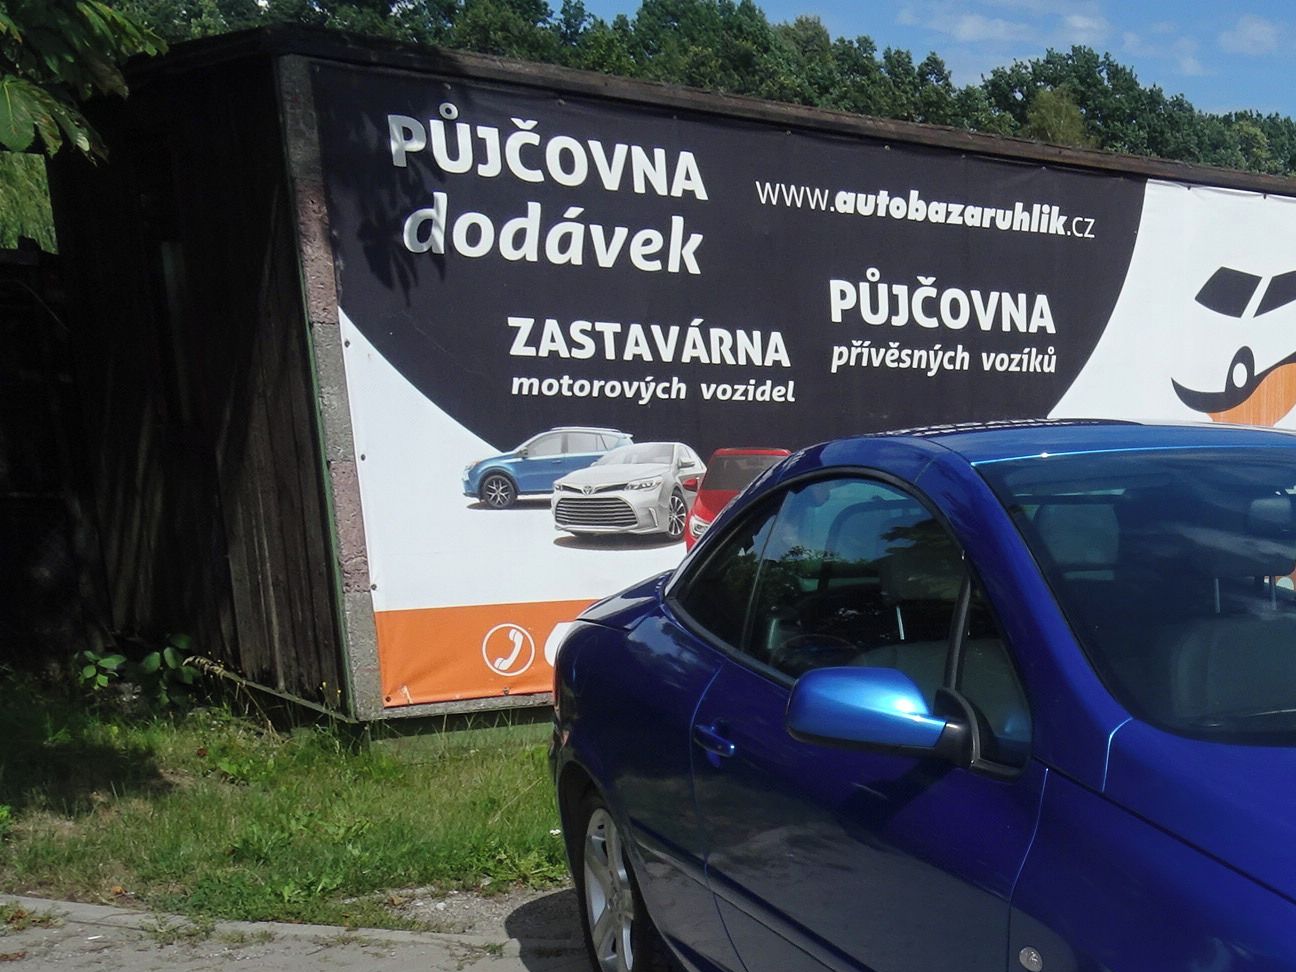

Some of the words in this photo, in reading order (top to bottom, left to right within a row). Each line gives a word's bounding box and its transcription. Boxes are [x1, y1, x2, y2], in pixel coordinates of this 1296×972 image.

[387, 102, 709, 200] PŮJČOVNA
[403, 191, 704, 275] dodávek
[754, 180, 1096, 238] www.autobazaruhlik.cz
[829, 267, 1057, 334] PŮJČOVNA
[507, 316, 792, 368] ZASTAVÁRNA
[831, 339, 970, 377] přívěsných
[981, 345, 1057, 374] vozíků
[511, 375, 687, 405] motorových
[700, 379, 796, 402] vozidel
